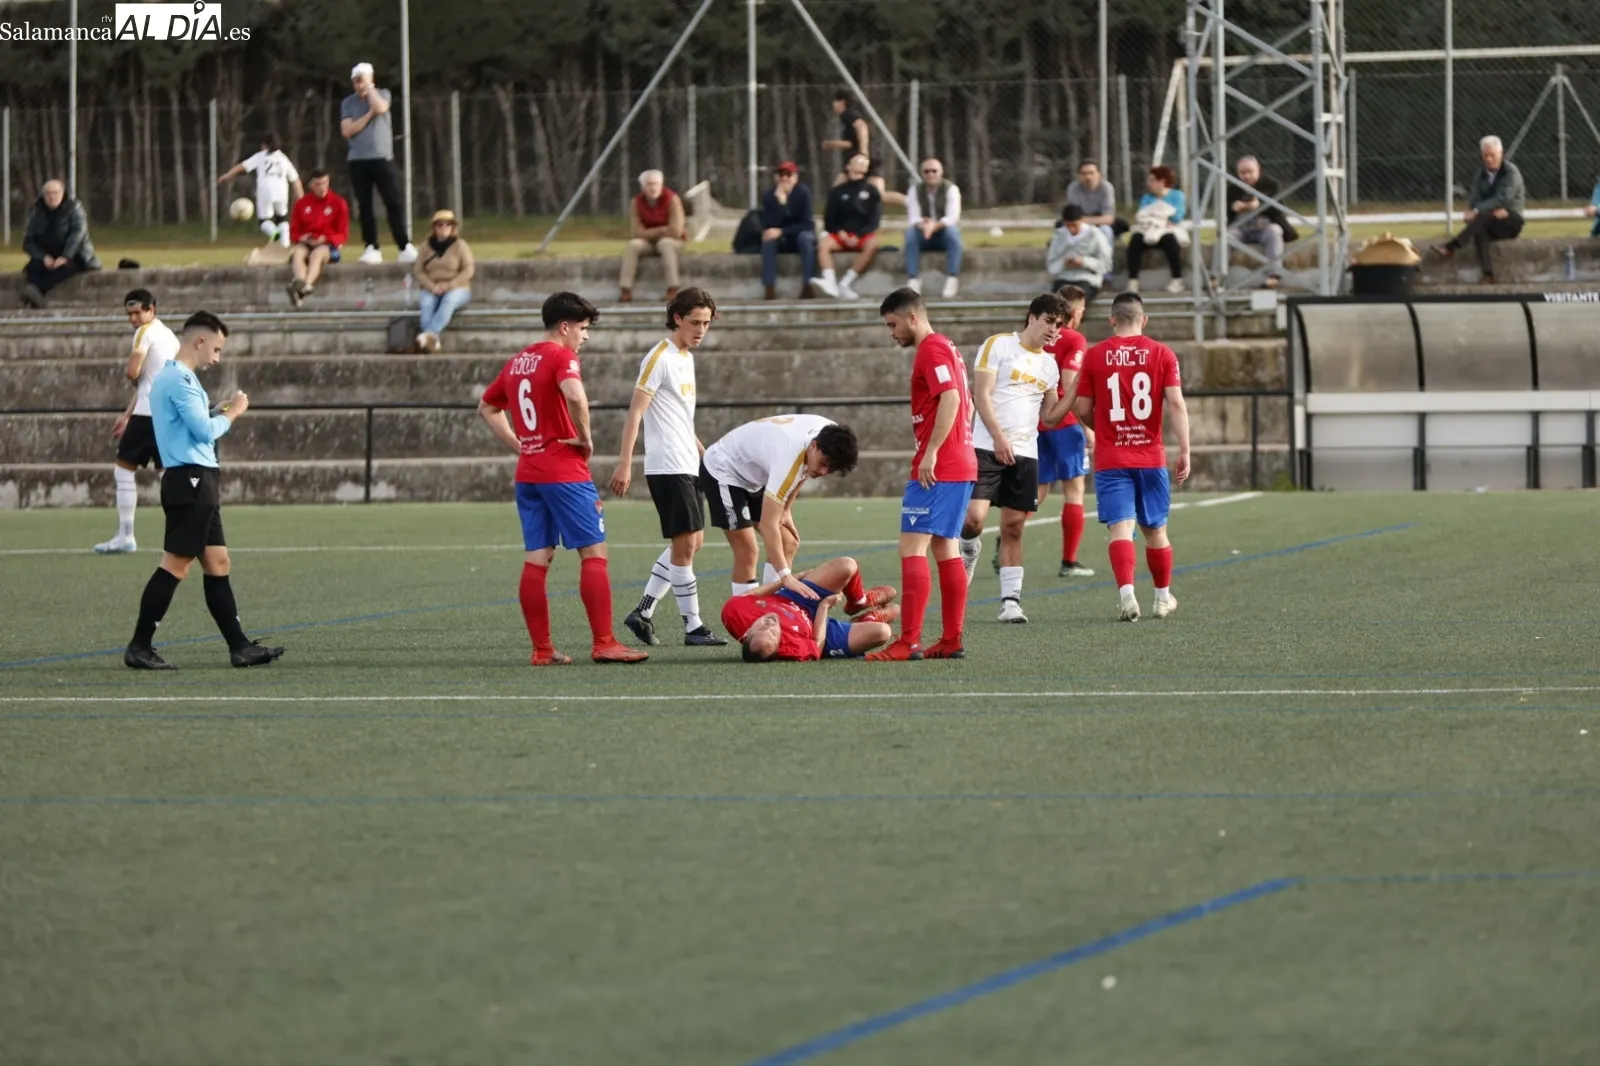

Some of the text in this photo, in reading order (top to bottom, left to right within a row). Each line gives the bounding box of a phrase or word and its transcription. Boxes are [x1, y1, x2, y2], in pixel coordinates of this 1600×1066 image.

[1543, 292, 1599, 303] VISITANTE
[1106, 349, 1149, 366] HLT
[518, 378, 537, 432] 6
[1106, 371, 1153, 422] 18
[598, 517, 605, 533] 6
